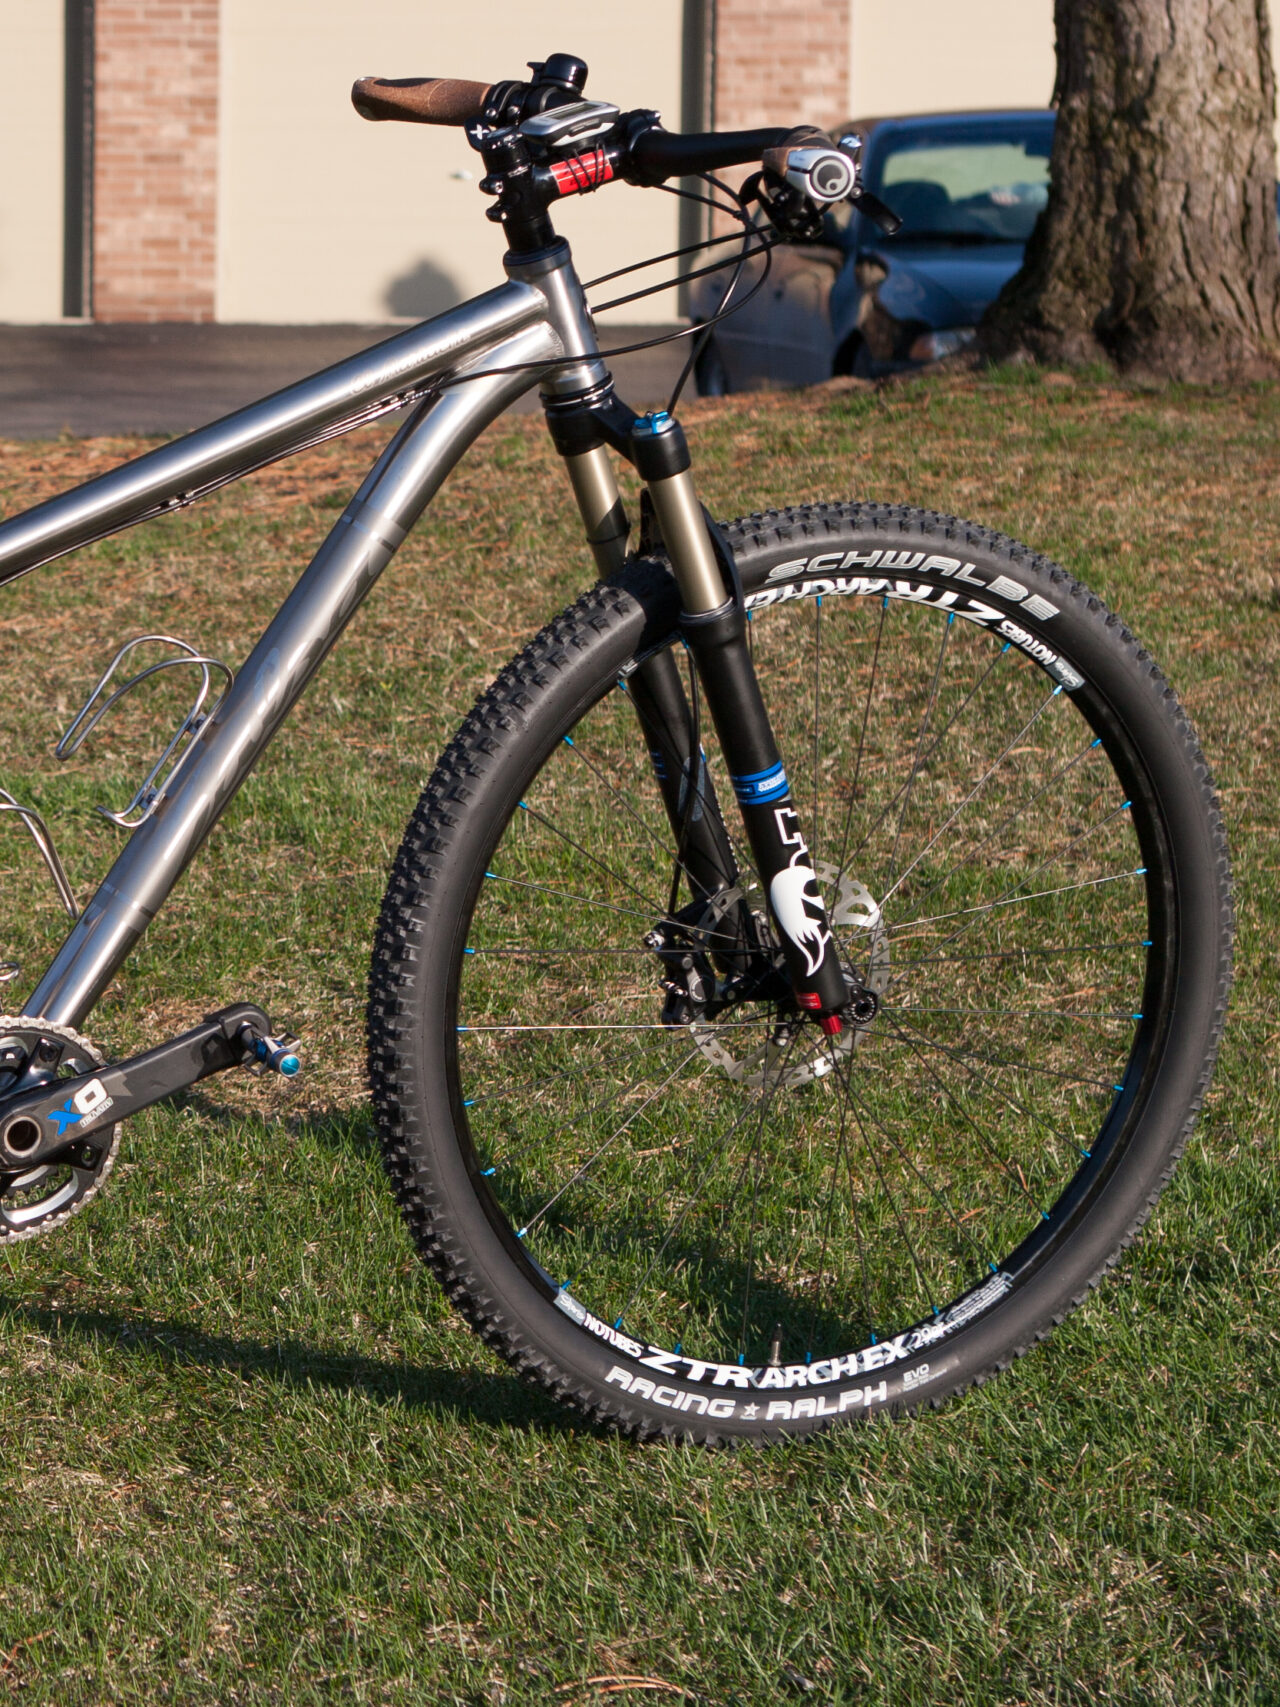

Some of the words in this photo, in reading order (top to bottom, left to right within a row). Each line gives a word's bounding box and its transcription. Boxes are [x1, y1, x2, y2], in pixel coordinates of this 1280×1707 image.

[765, 550, 1061, 622] SCHWALBE
[886, 581, 1007, 627] ZTR
[997, 620, 1058, 666] NOTUBES
[584, 1311, 645, 1358] NOTUBES
[638, 1345, 754, 1388] ZTR
[903, 1363, 930, 1382] EVO
[604, 1365, 736, 1419] RACING
[765, 1380, 888, 1421] RALPH
